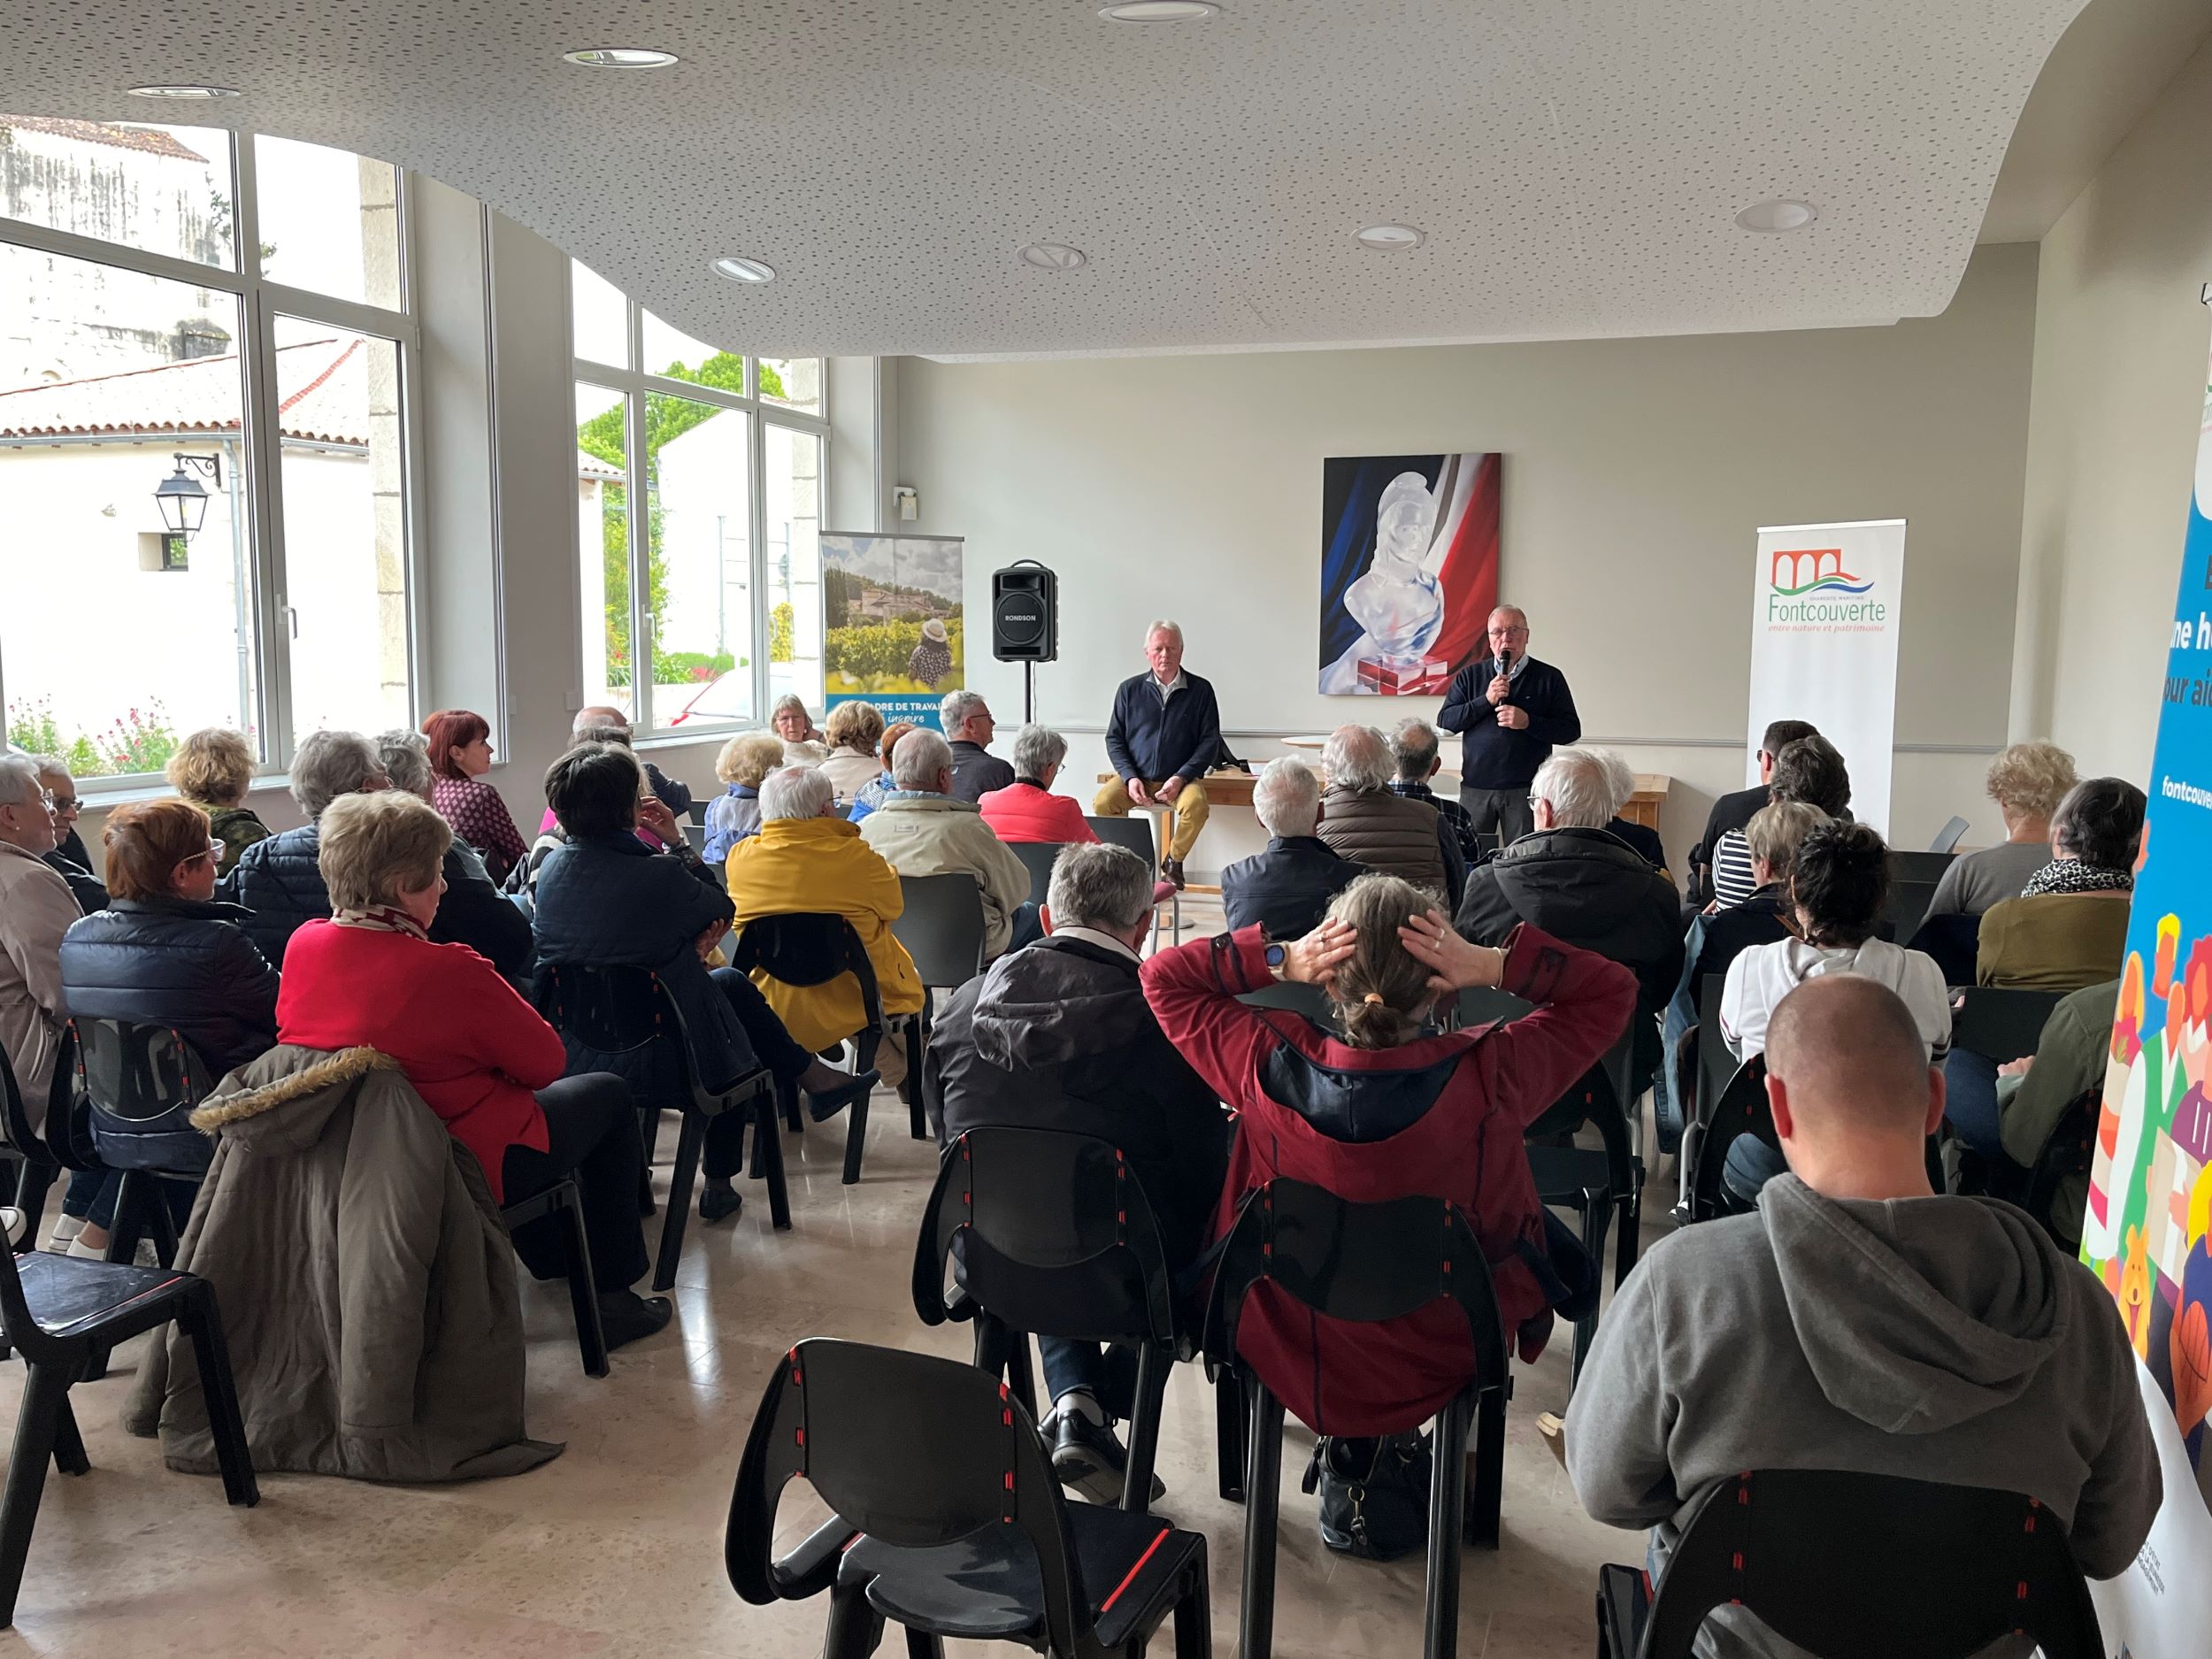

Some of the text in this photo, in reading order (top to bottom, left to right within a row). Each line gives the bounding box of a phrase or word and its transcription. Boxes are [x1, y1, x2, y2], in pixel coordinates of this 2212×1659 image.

[1769, 594, 1886, 622] Fontcouverte
[1832, 624, 1885, 634] patrimoine
[2196, 611, 2212, 650] h
[895, 702, 909, 710] DE
